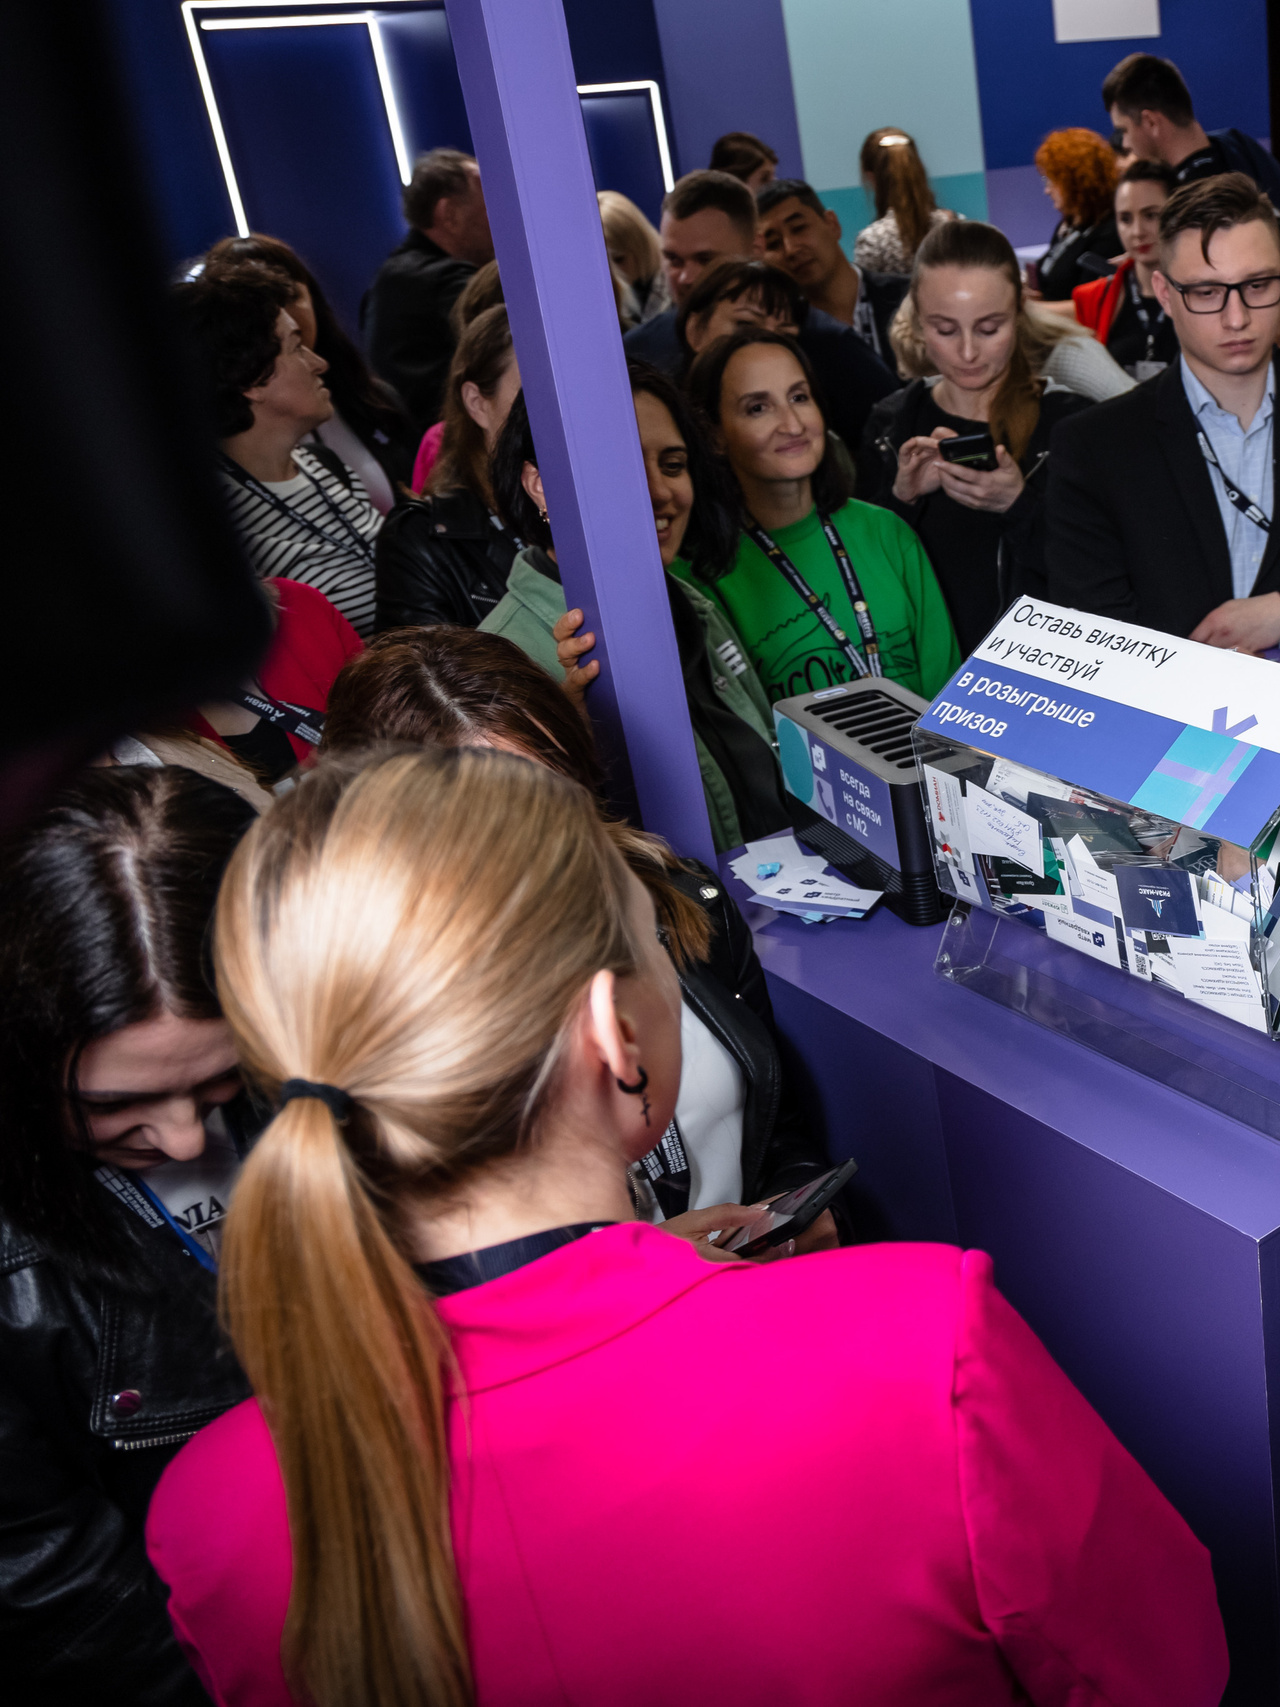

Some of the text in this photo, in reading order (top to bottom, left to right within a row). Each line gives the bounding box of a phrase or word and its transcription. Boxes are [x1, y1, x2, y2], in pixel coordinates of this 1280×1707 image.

[1013, 604, 1177, 668] Оставь визитку
[986, 636, 1104, 684] и участвуй
[931, 698, 1008, 739] призов
[956, 670, 1096, 729] в розыгрыше
[840, 768, 870, 798] всегда
[843, 790, 882, 826] на связи
[846, 813, 868, 837] с М2
